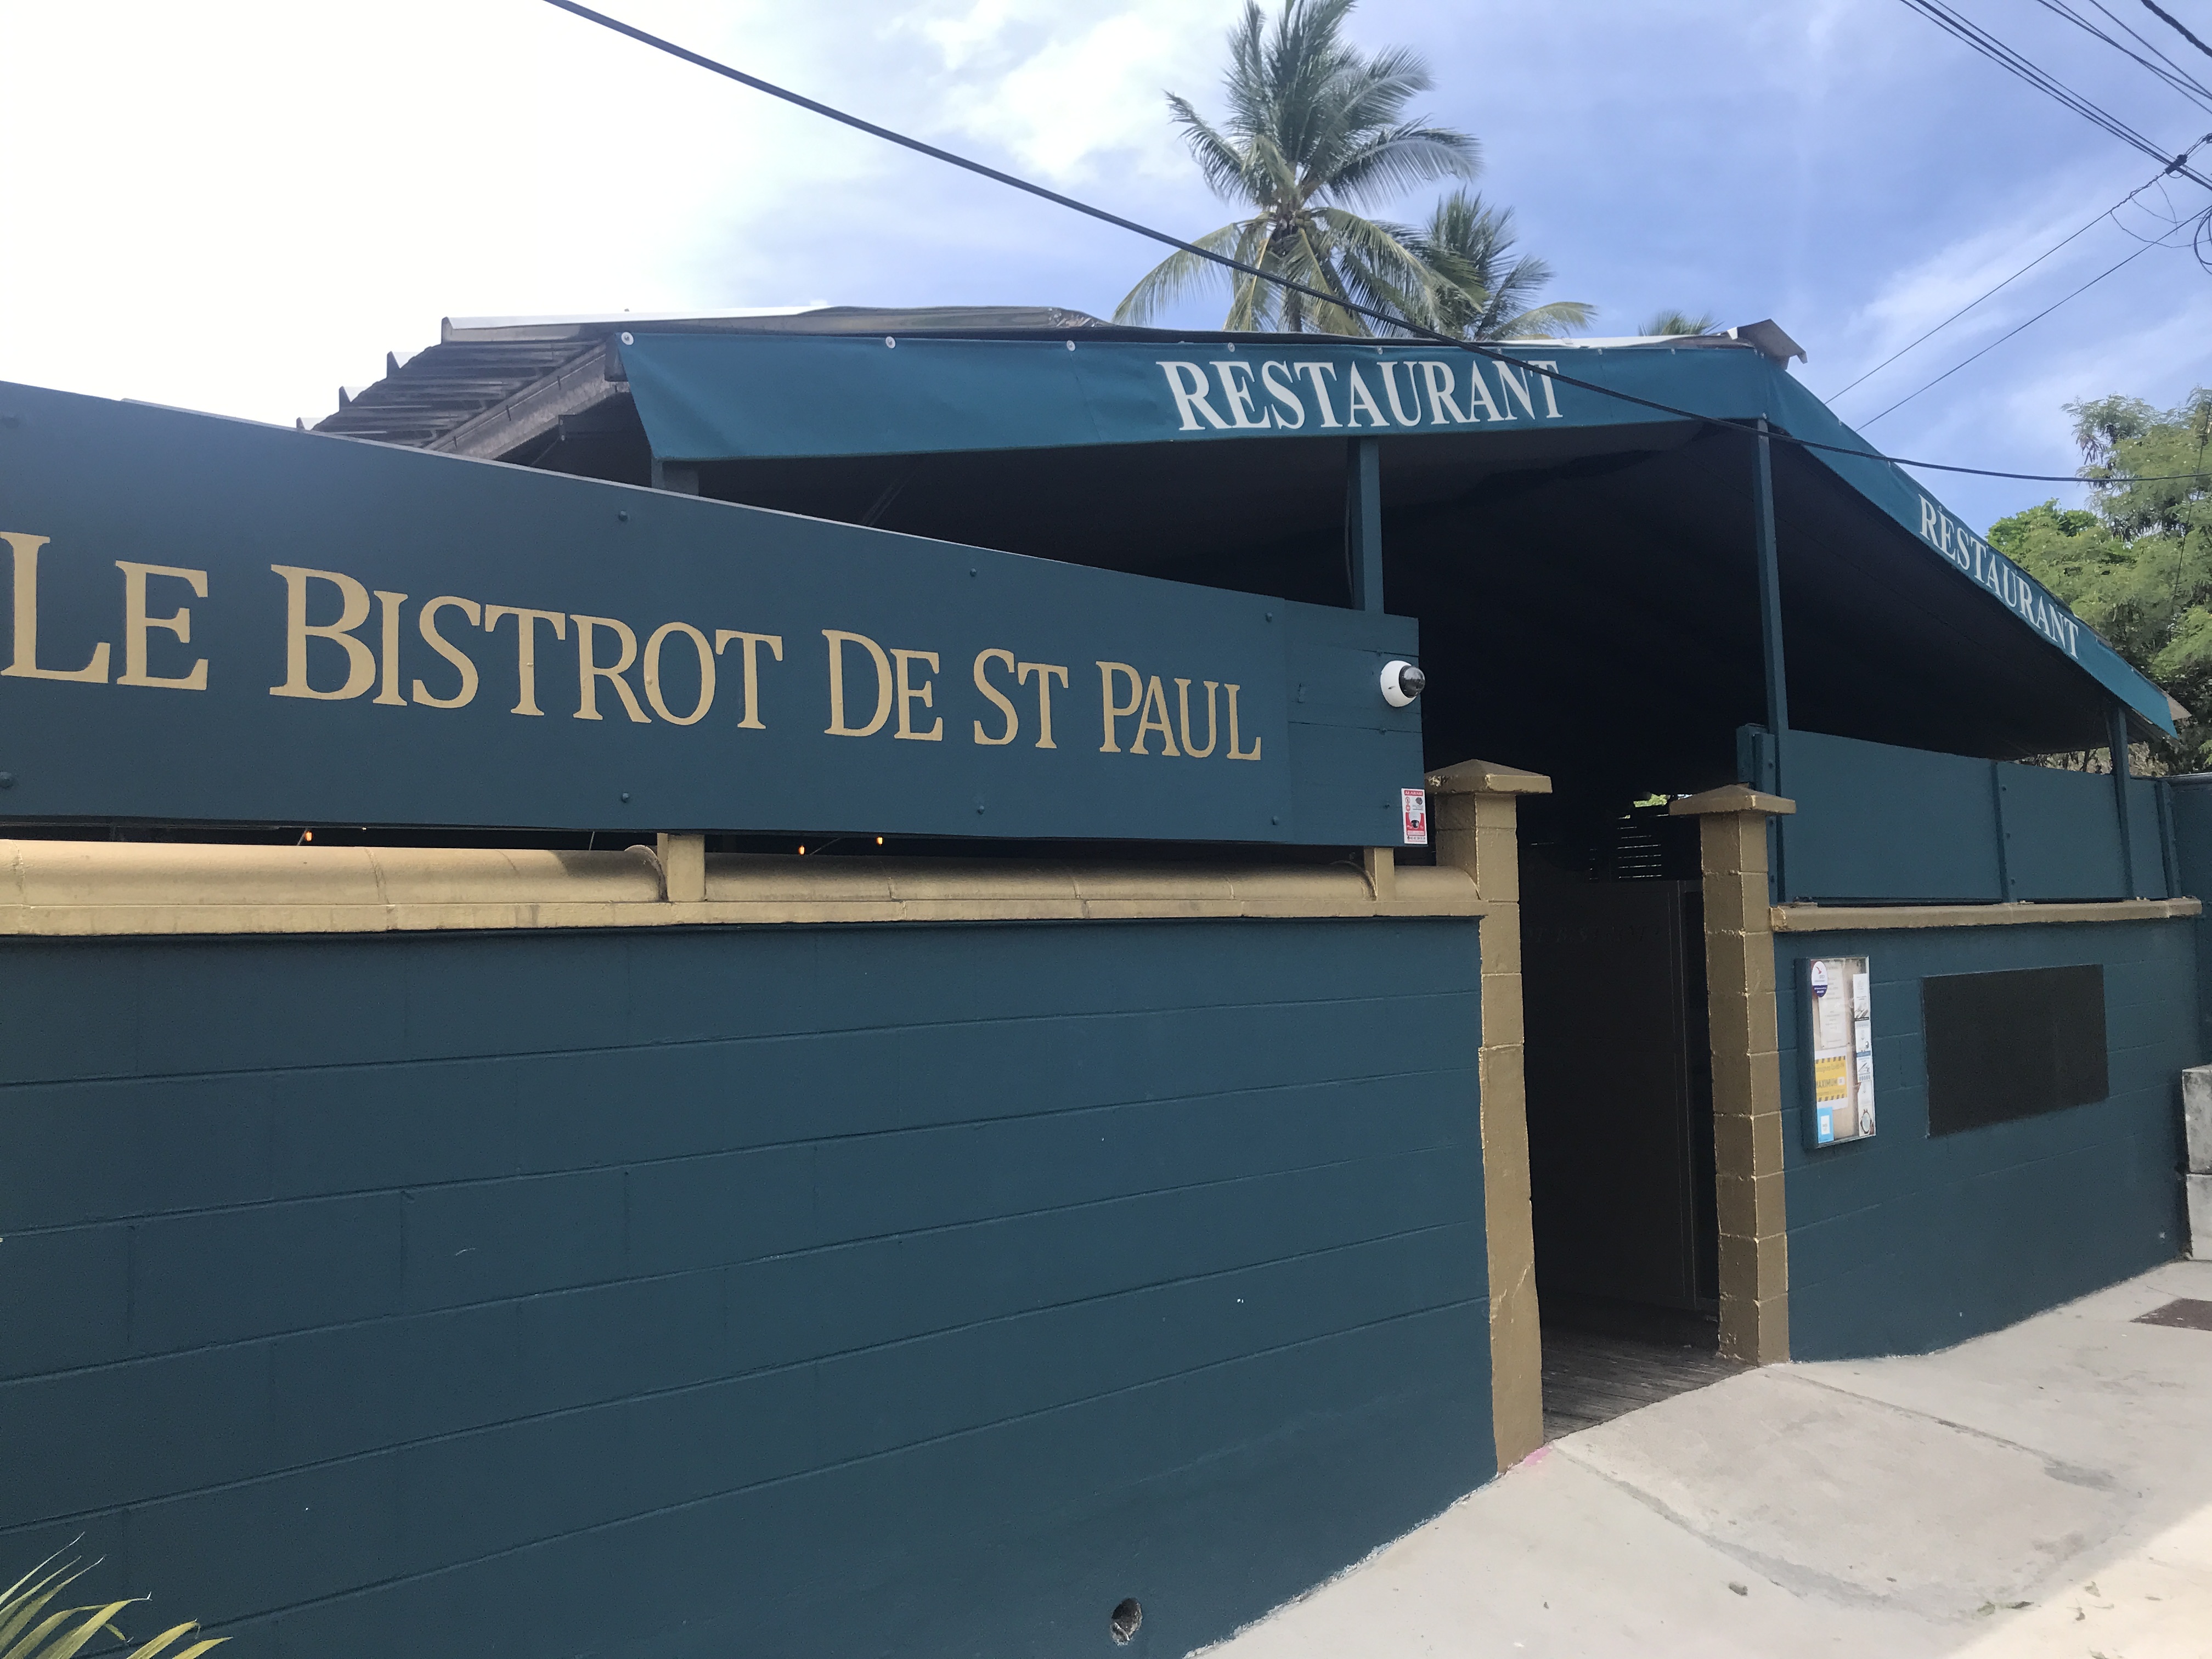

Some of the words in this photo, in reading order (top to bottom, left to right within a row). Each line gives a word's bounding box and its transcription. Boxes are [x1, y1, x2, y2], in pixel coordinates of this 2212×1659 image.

[1155, 360, 1564, 431] RESTAURANT
[0, 532, 208, 691] LE
[269, 564, 783, 729] BISTROT
[822, 629, 943, 742] DE
[974, 648, 1069, 749] ST
[1096, 661, 1261, 761] PAUL
[1918, 493, 2079, 660] RESTAURANT
